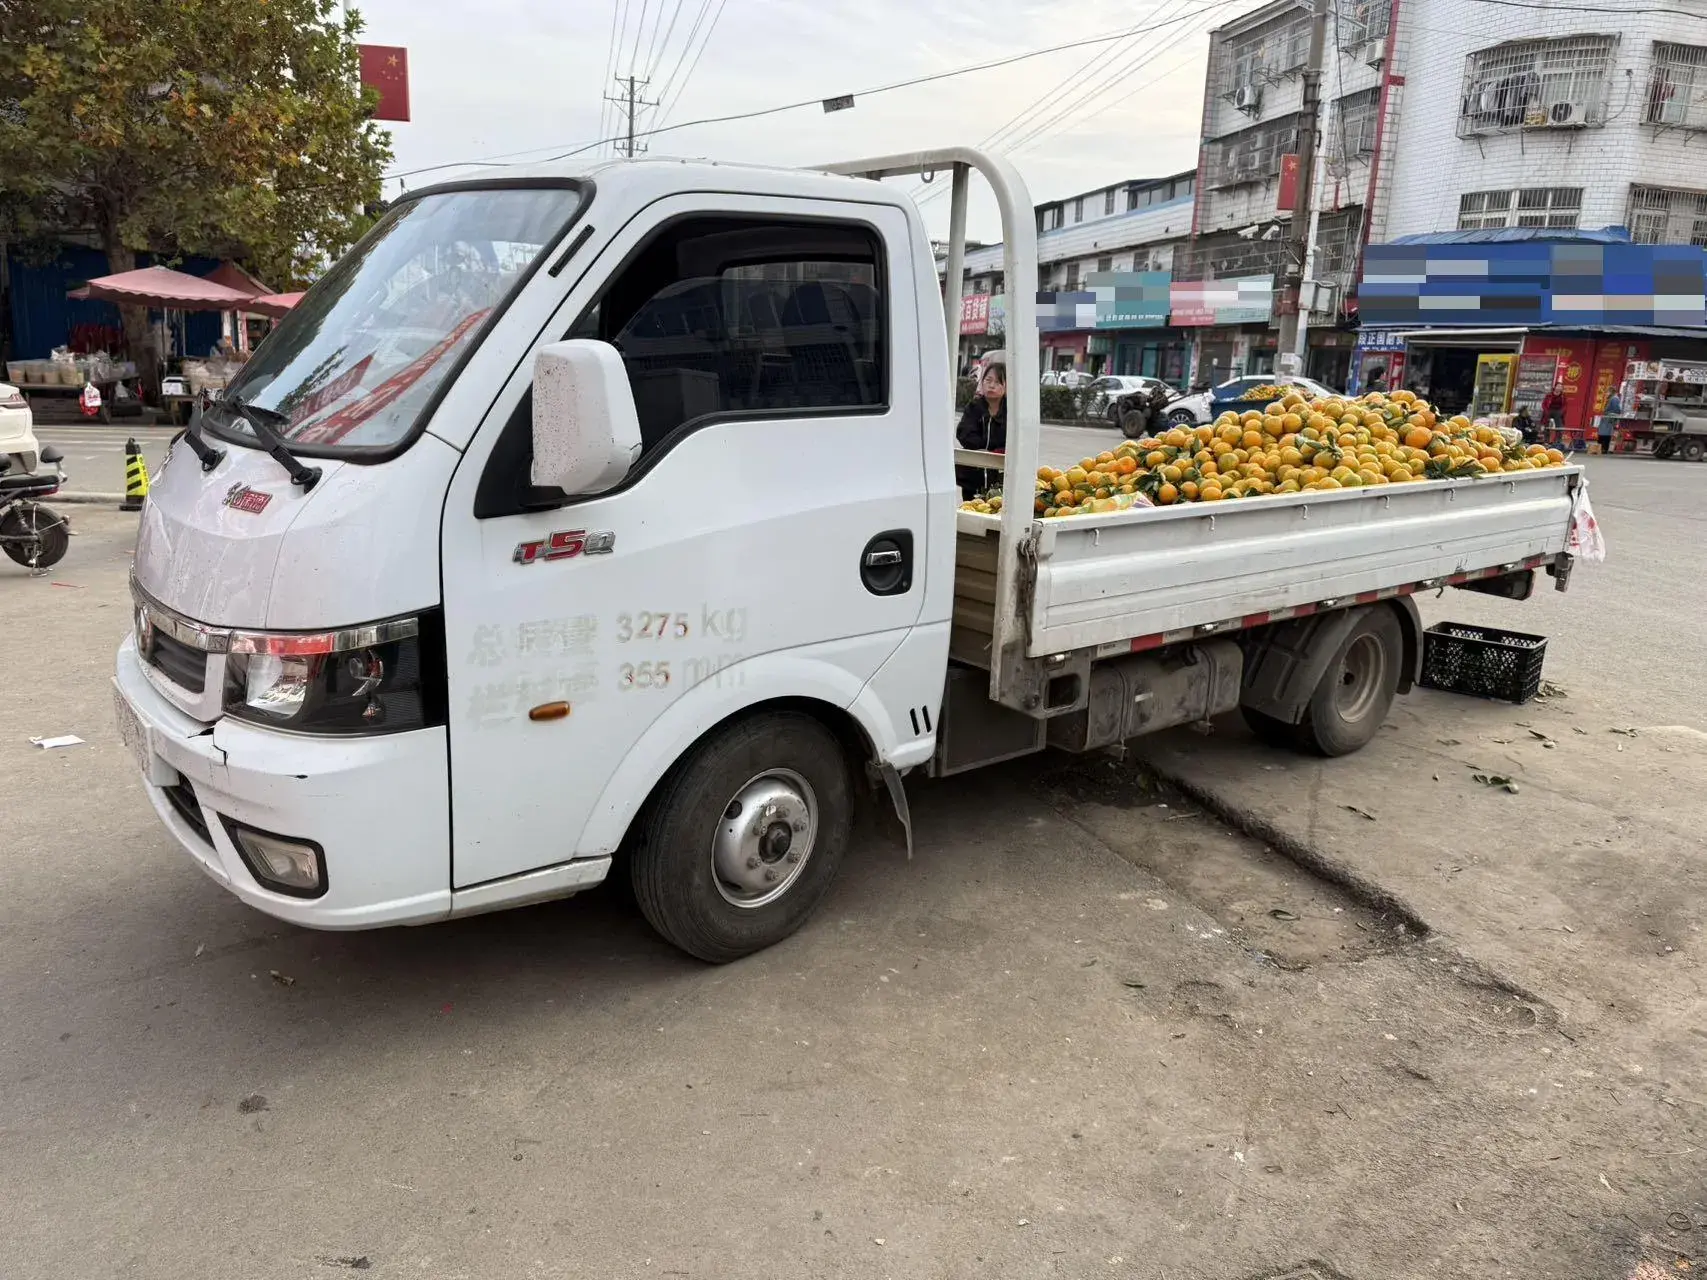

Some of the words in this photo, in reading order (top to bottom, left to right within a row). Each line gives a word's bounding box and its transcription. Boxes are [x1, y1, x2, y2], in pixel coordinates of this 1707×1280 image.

[512, 528, 616, 565] T5Q
[616, 610, 691, 646] 3275
[700, 601, 748, 641] kg
[617, 659, 672, 693] 355
[682, 650, 746, 692] mm
